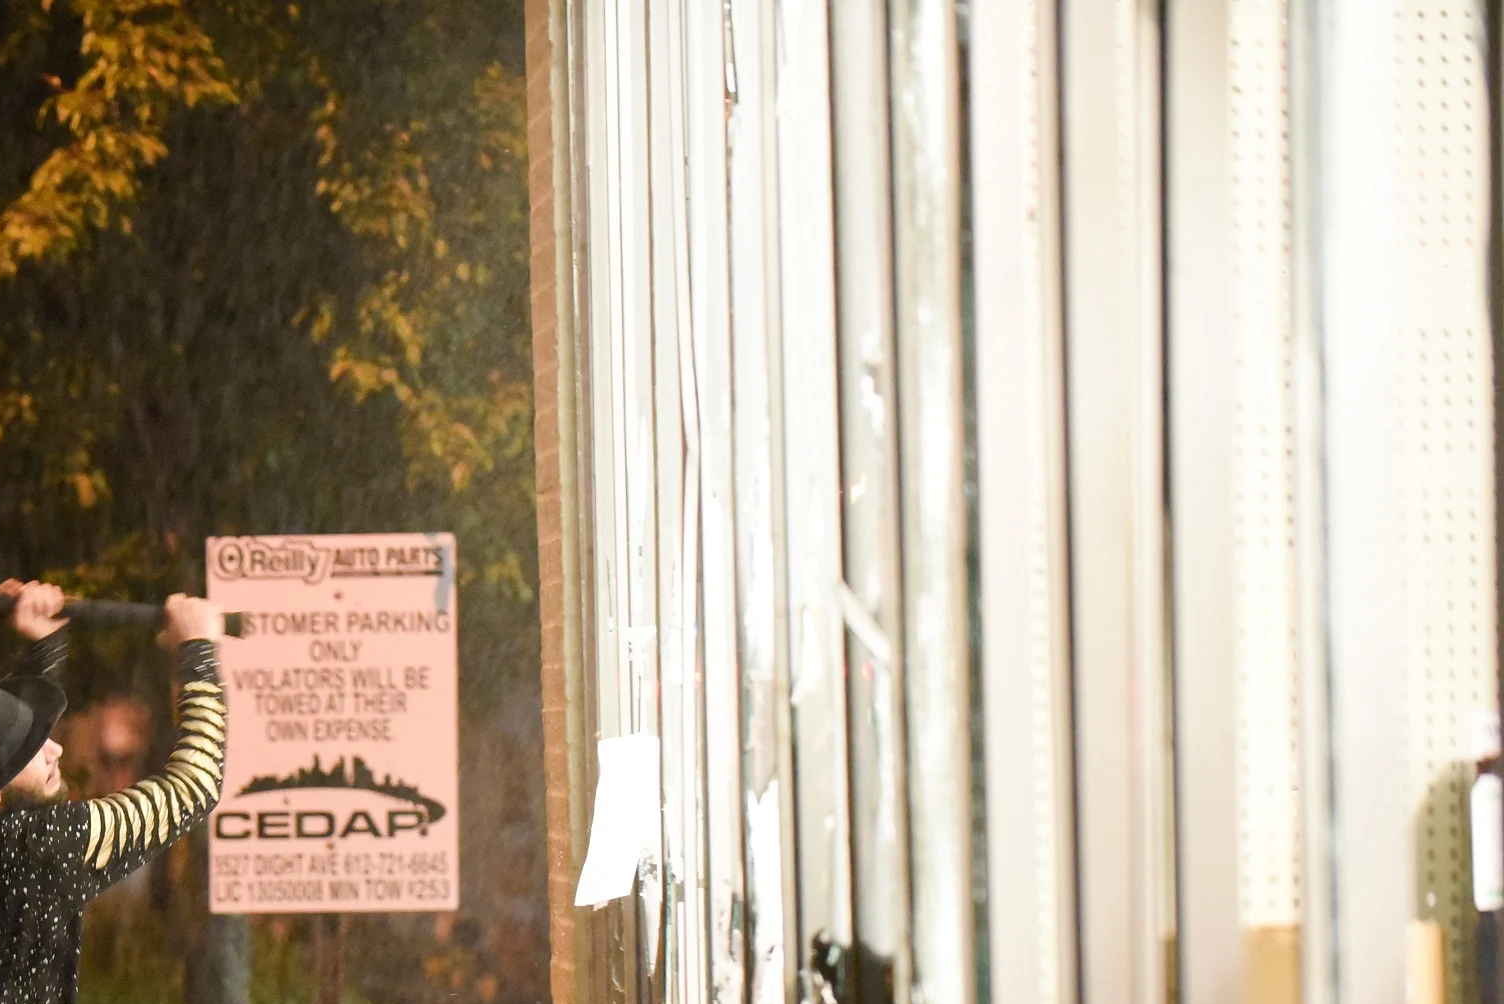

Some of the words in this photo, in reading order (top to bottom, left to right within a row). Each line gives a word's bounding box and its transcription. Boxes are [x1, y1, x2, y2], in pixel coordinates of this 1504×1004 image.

[332, 548, 379, 569] AUTO
[385, 547, 444, 569] PARTS
[243, 613, 339, 636] STOMER
[346, 612, 451, 635] PARKING
[309, 640, 362, 663] ONLY
[232, 669, 345, 692] VIOLATORS
[351, 667, 398, 690] WILL
[404, 666, 431, 690] BE
[254, 693, 321, 716] TOWED
[325, 692, 345, 715] AT
[352, 691, 407, 714] THEIR
[267, 721, 307, 743] OWN
[308, 852, 339, 875] AVE
[365, 879, 402, 901] TOW
